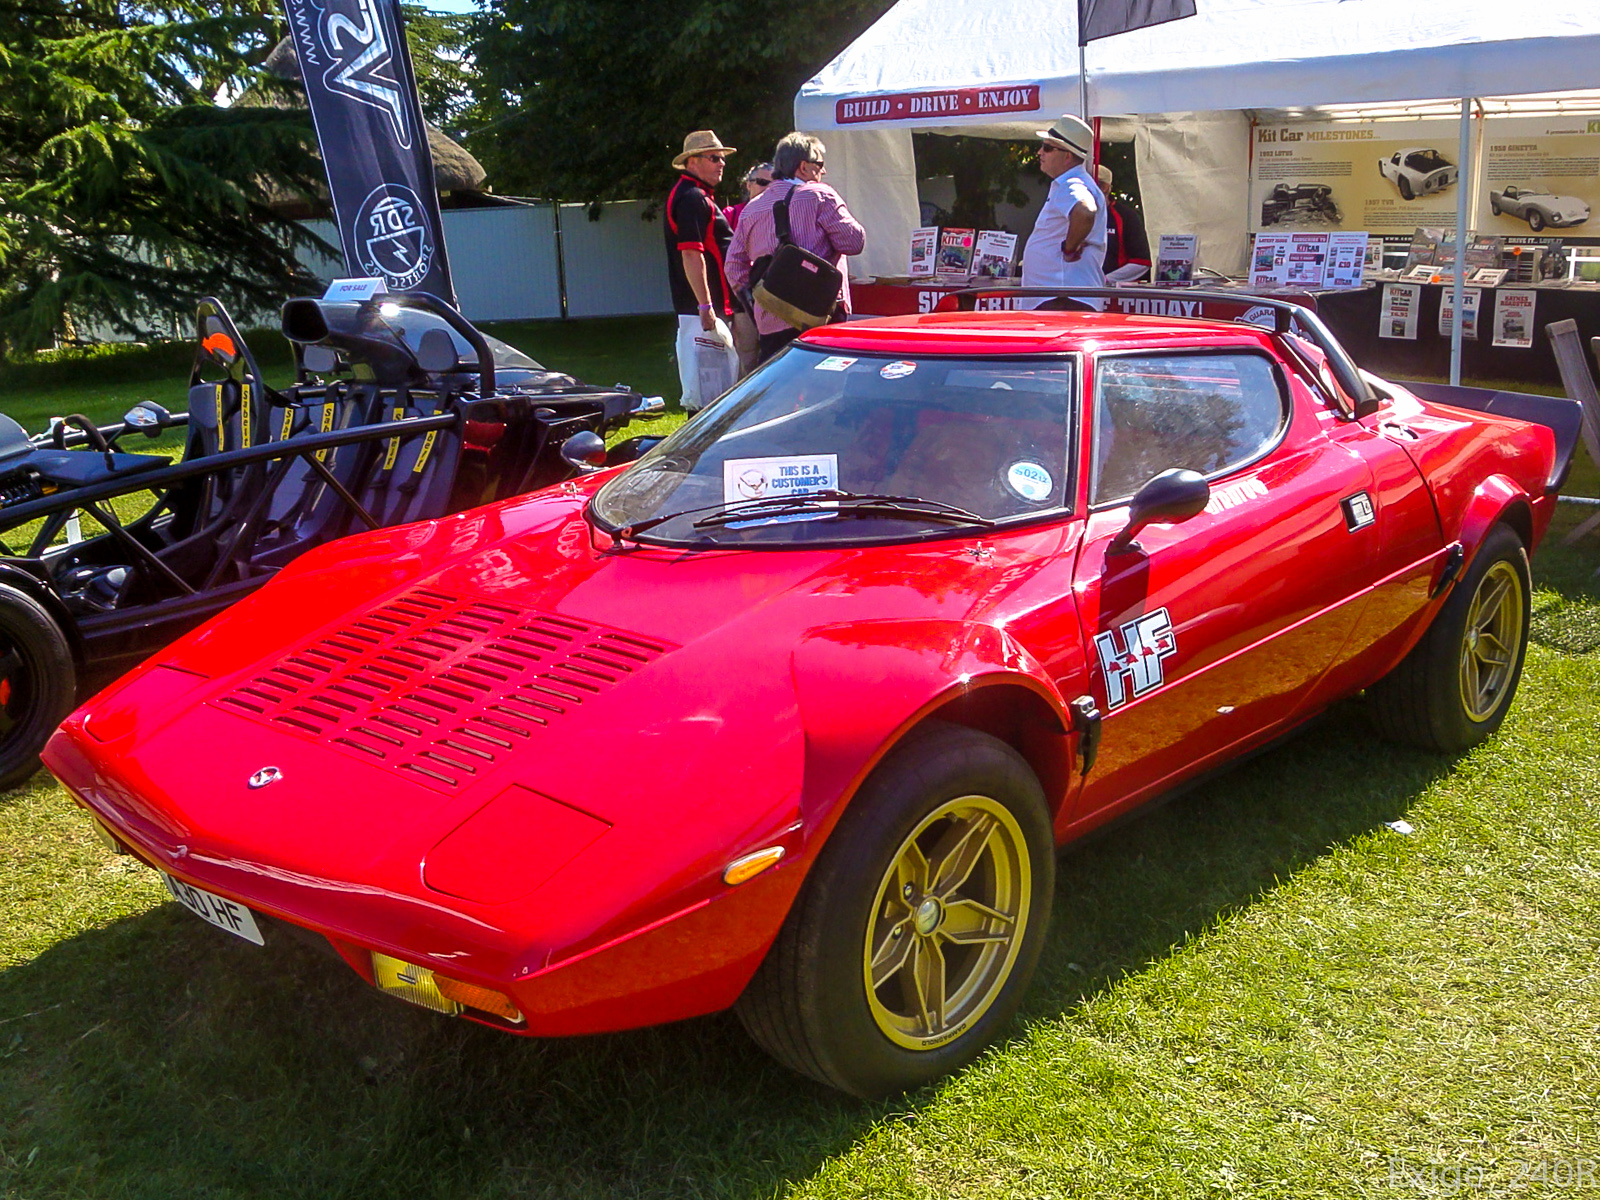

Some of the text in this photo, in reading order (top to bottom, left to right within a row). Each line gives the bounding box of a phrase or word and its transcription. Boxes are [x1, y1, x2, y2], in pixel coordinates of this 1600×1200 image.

[844, 89, 1032, 118] BUILD DRIVE ENJOY
[1258, 129, 1277, 142] Kit
[1280, 128, 1304, 141] Car
[1296, 244, 1320, 253] KITCAR
[1389, 287, 1413, 297] KITCAR
[1118, 297, 1203, 319] TODAY!
[779, 464, 820, 476] THIS IS A
[771, 475, 828, 489] CUSTOMER'S
[1094, 608, 1177, 710] HF
[206, 894, 243, 931] HF
[921, 1023, 967, 1046] CAMPAGNOLO
